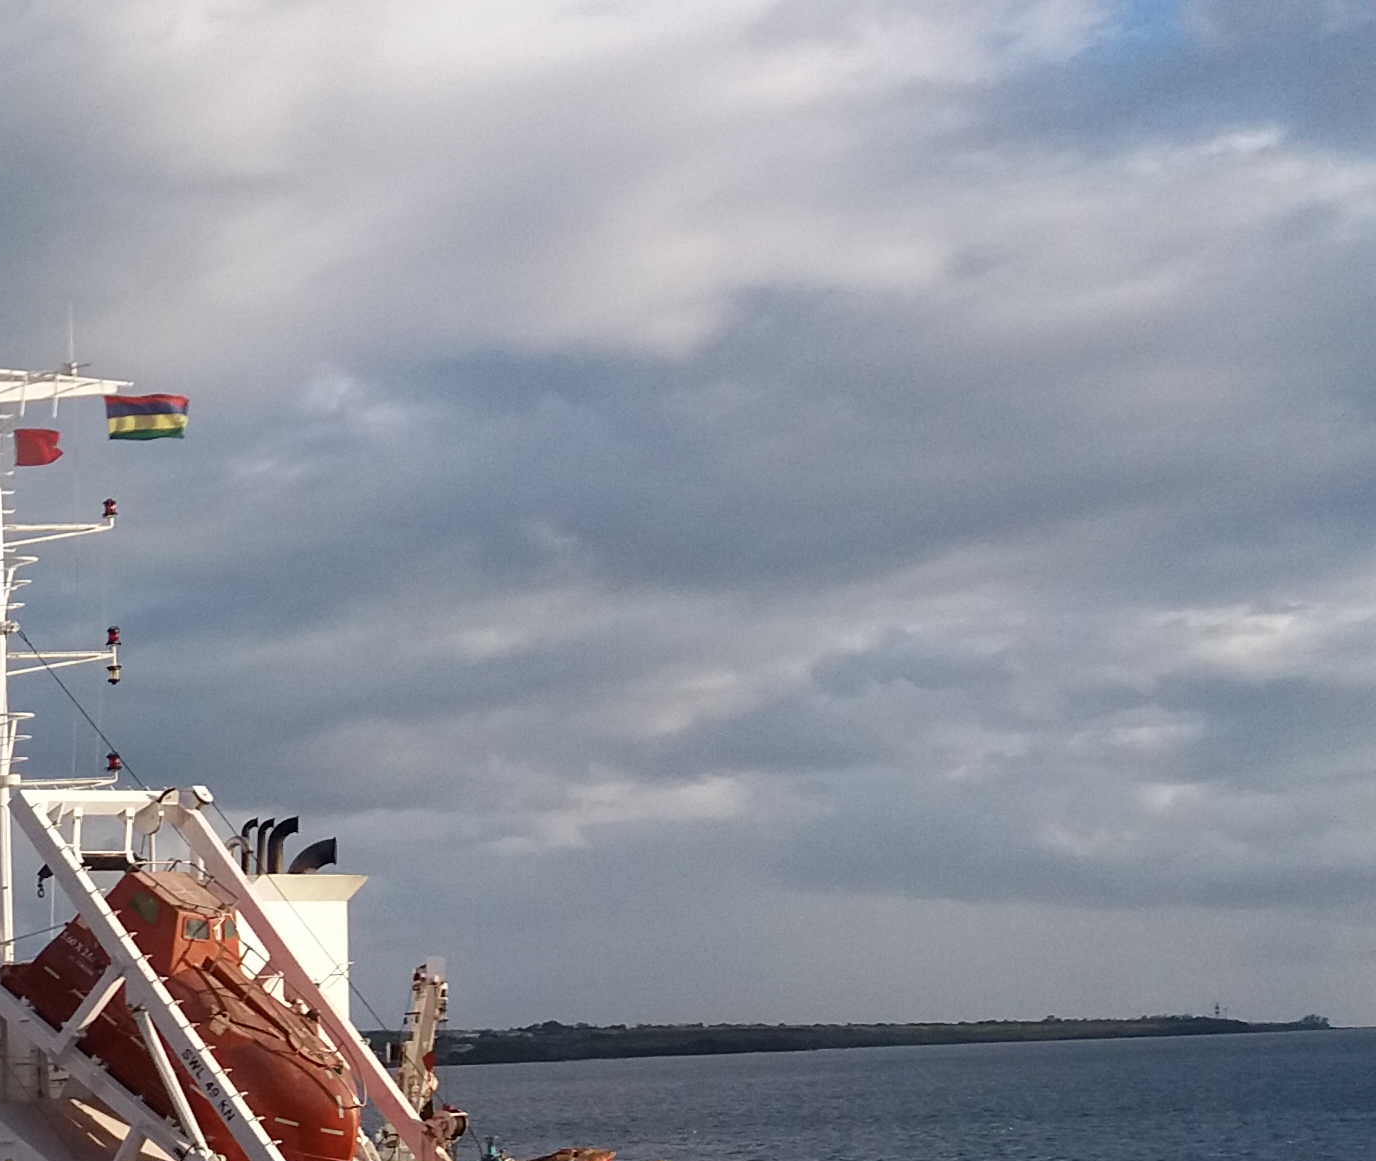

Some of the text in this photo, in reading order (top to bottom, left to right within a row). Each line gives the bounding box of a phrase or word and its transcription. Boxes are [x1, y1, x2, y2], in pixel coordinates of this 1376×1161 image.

[181, 1048, 236, 1121] SWL 49 KN
